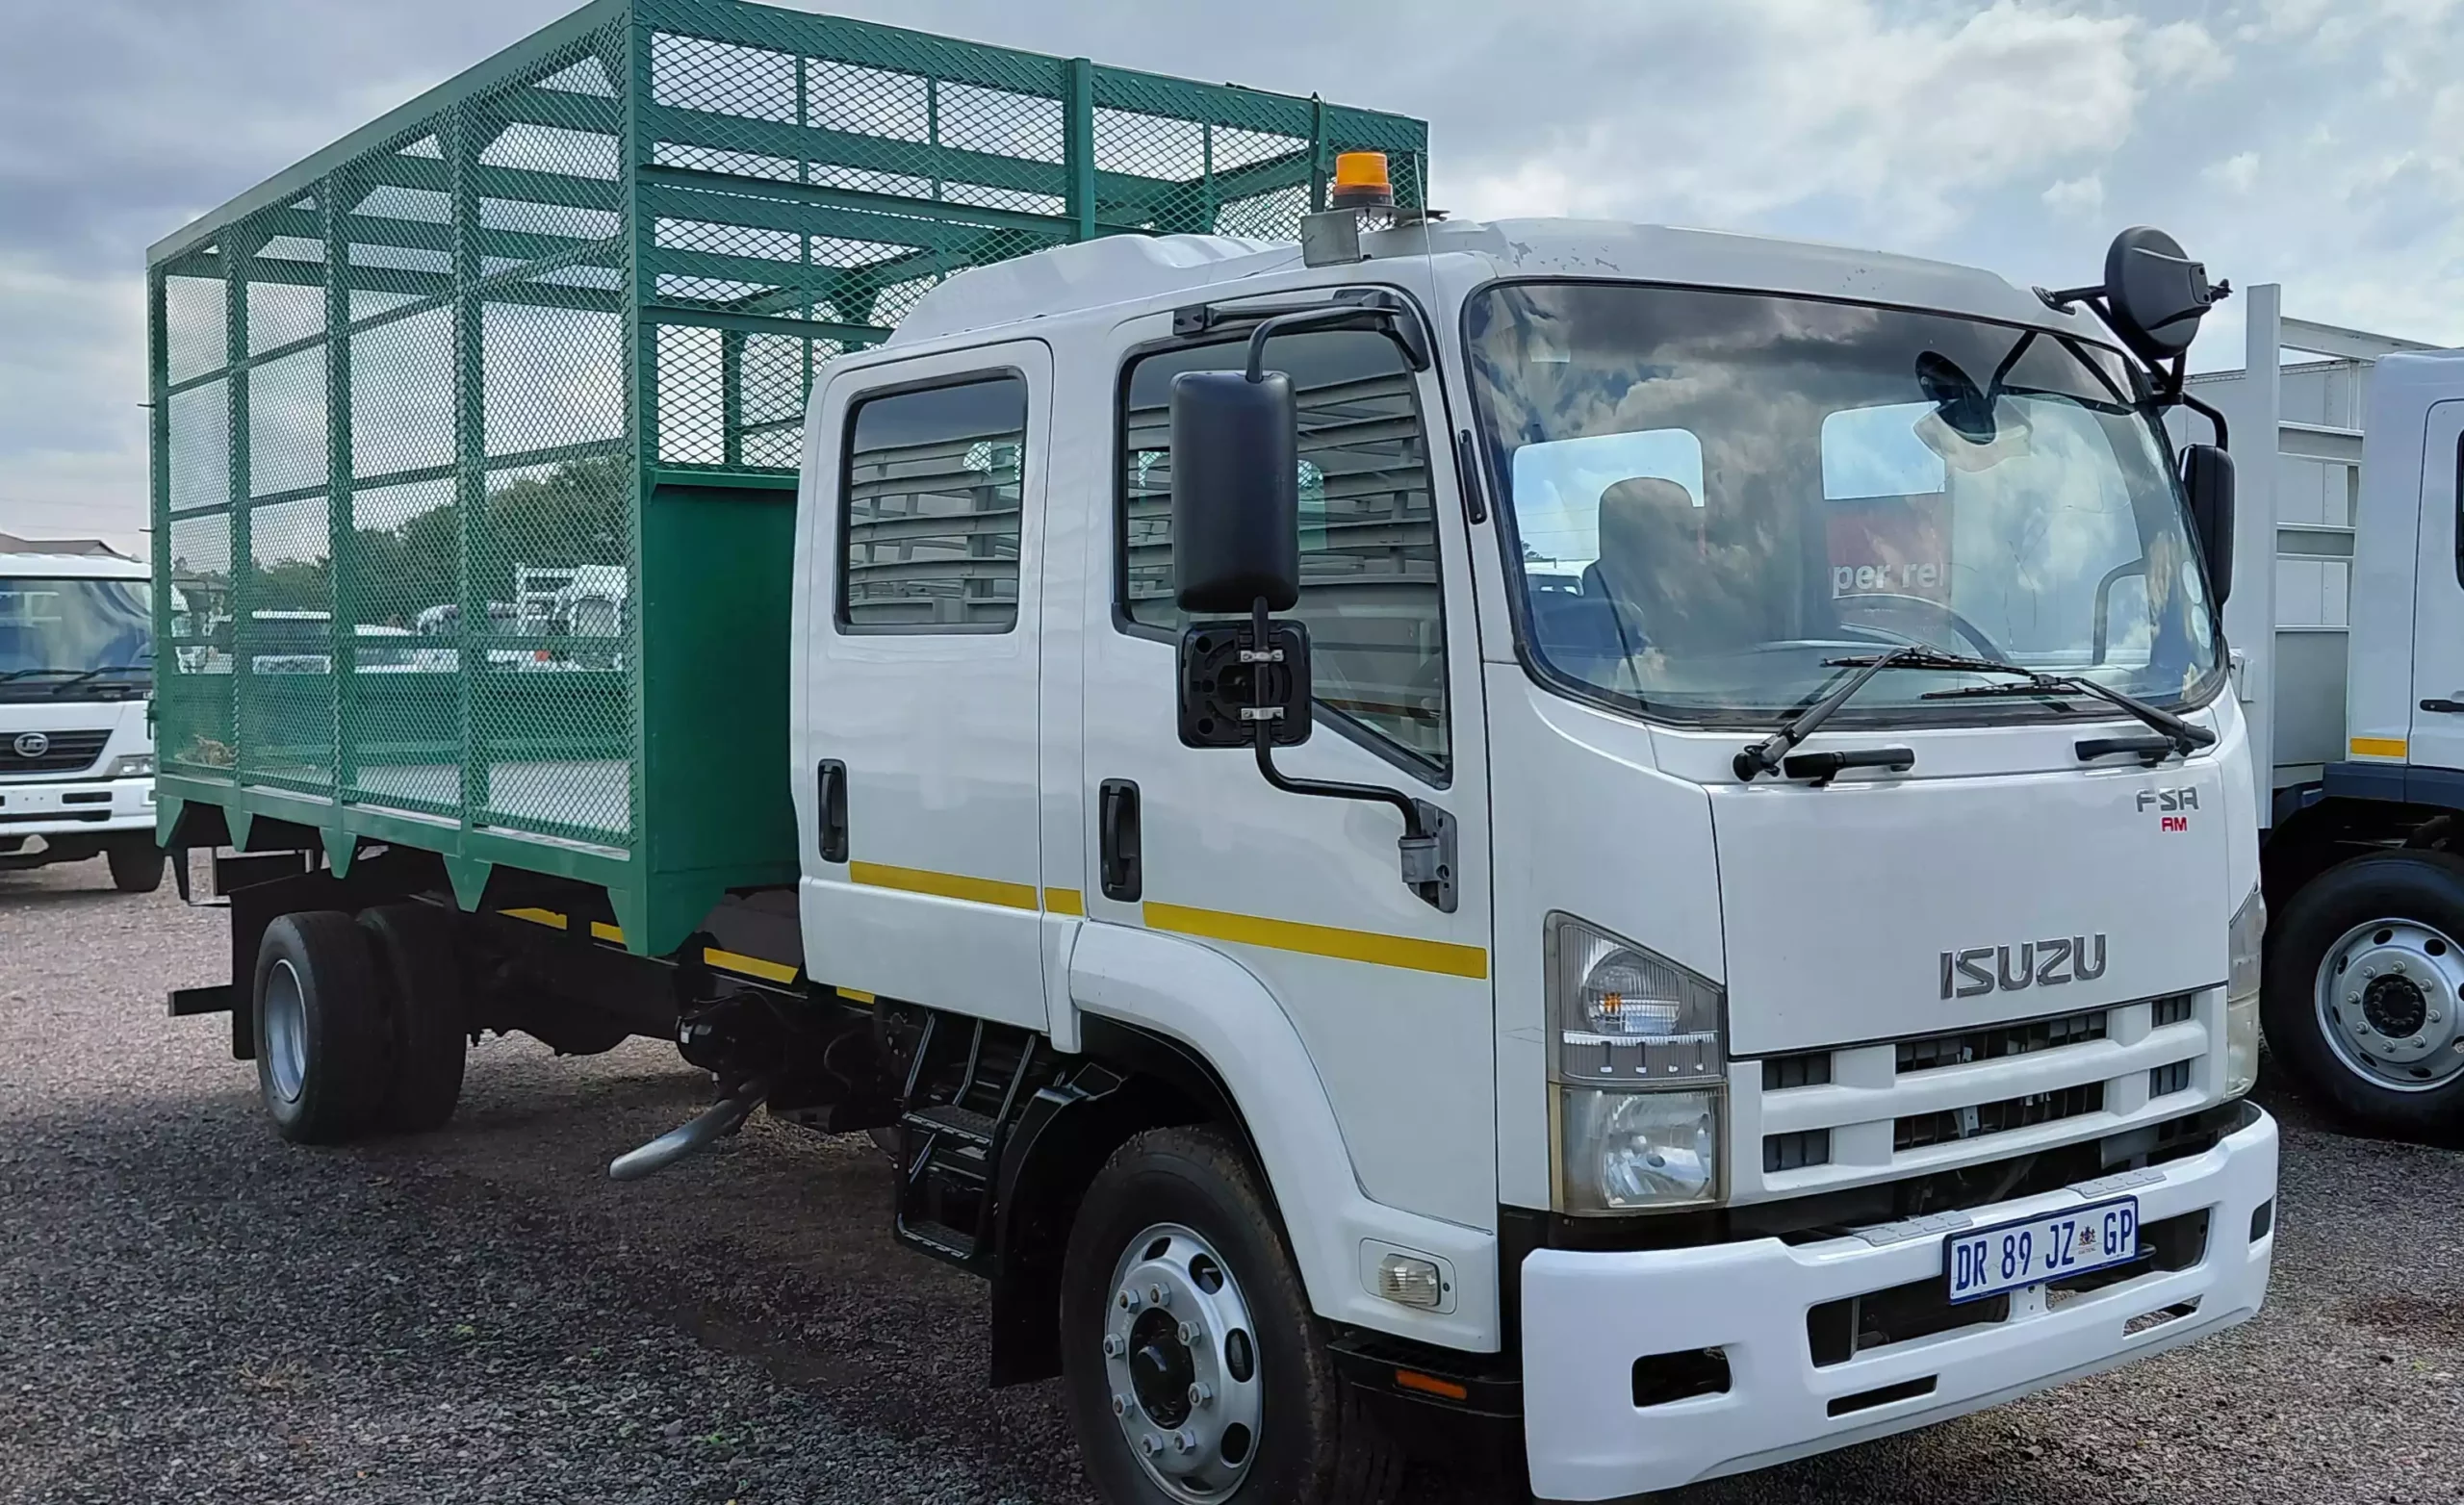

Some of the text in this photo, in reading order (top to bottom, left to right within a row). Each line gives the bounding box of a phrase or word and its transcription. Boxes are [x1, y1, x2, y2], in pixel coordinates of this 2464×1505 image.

[1833, 565, 1891, 599] per
[2136, 787, 2199, 812] FSR
[1939, 932, 2106, 1000] ISUZU
[1956, 1209, 2133, 1290] DR 89 JZ GP
